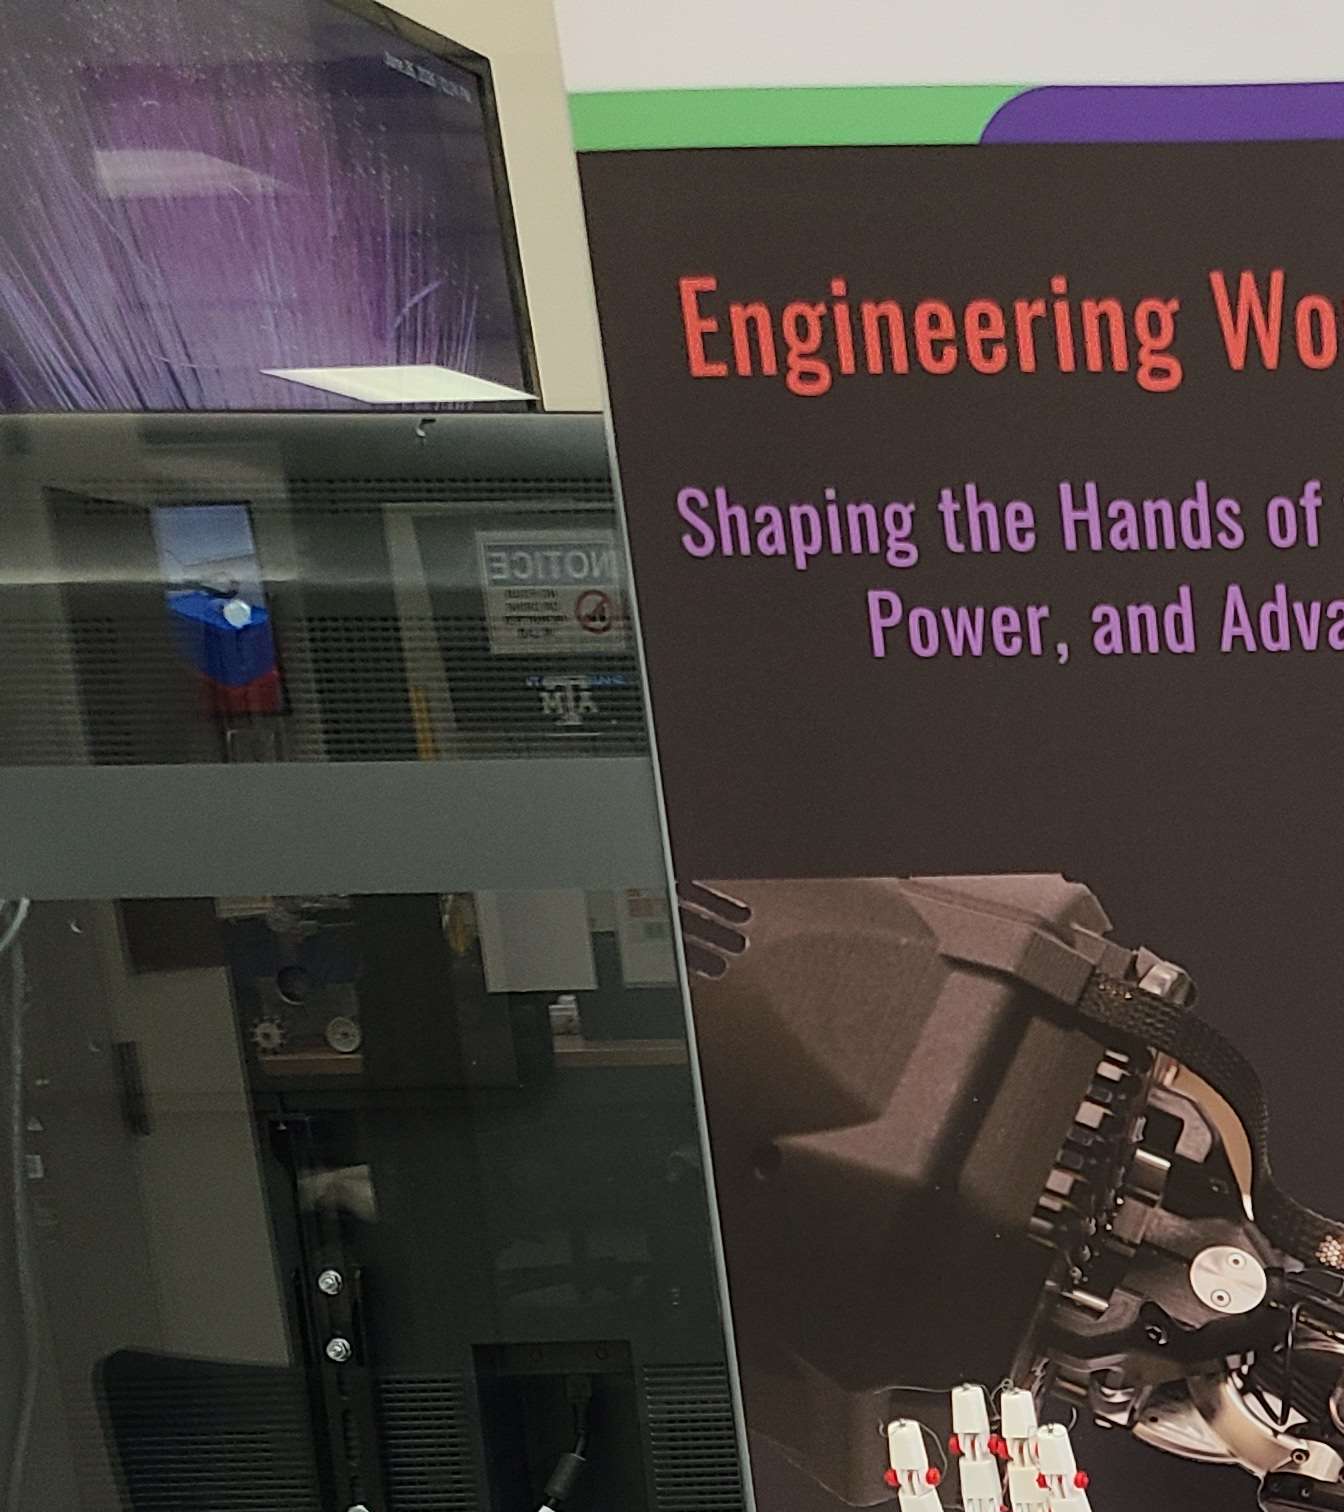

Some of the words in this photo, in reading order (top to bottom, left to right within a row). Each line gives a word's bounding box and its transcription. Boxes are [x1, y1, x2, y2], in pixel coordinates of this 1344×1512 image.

[679, 274, 1183, 396] Engineering
[677, 486, 918, 569] Shaping
[939, 482, 1036, 553] the
[1058, 481, 1245, 551] Hands
[1266, 481, 1322, 548] of
[867, 589, 1071, 664] Power,
[1092, 585, 1196, 654] and
